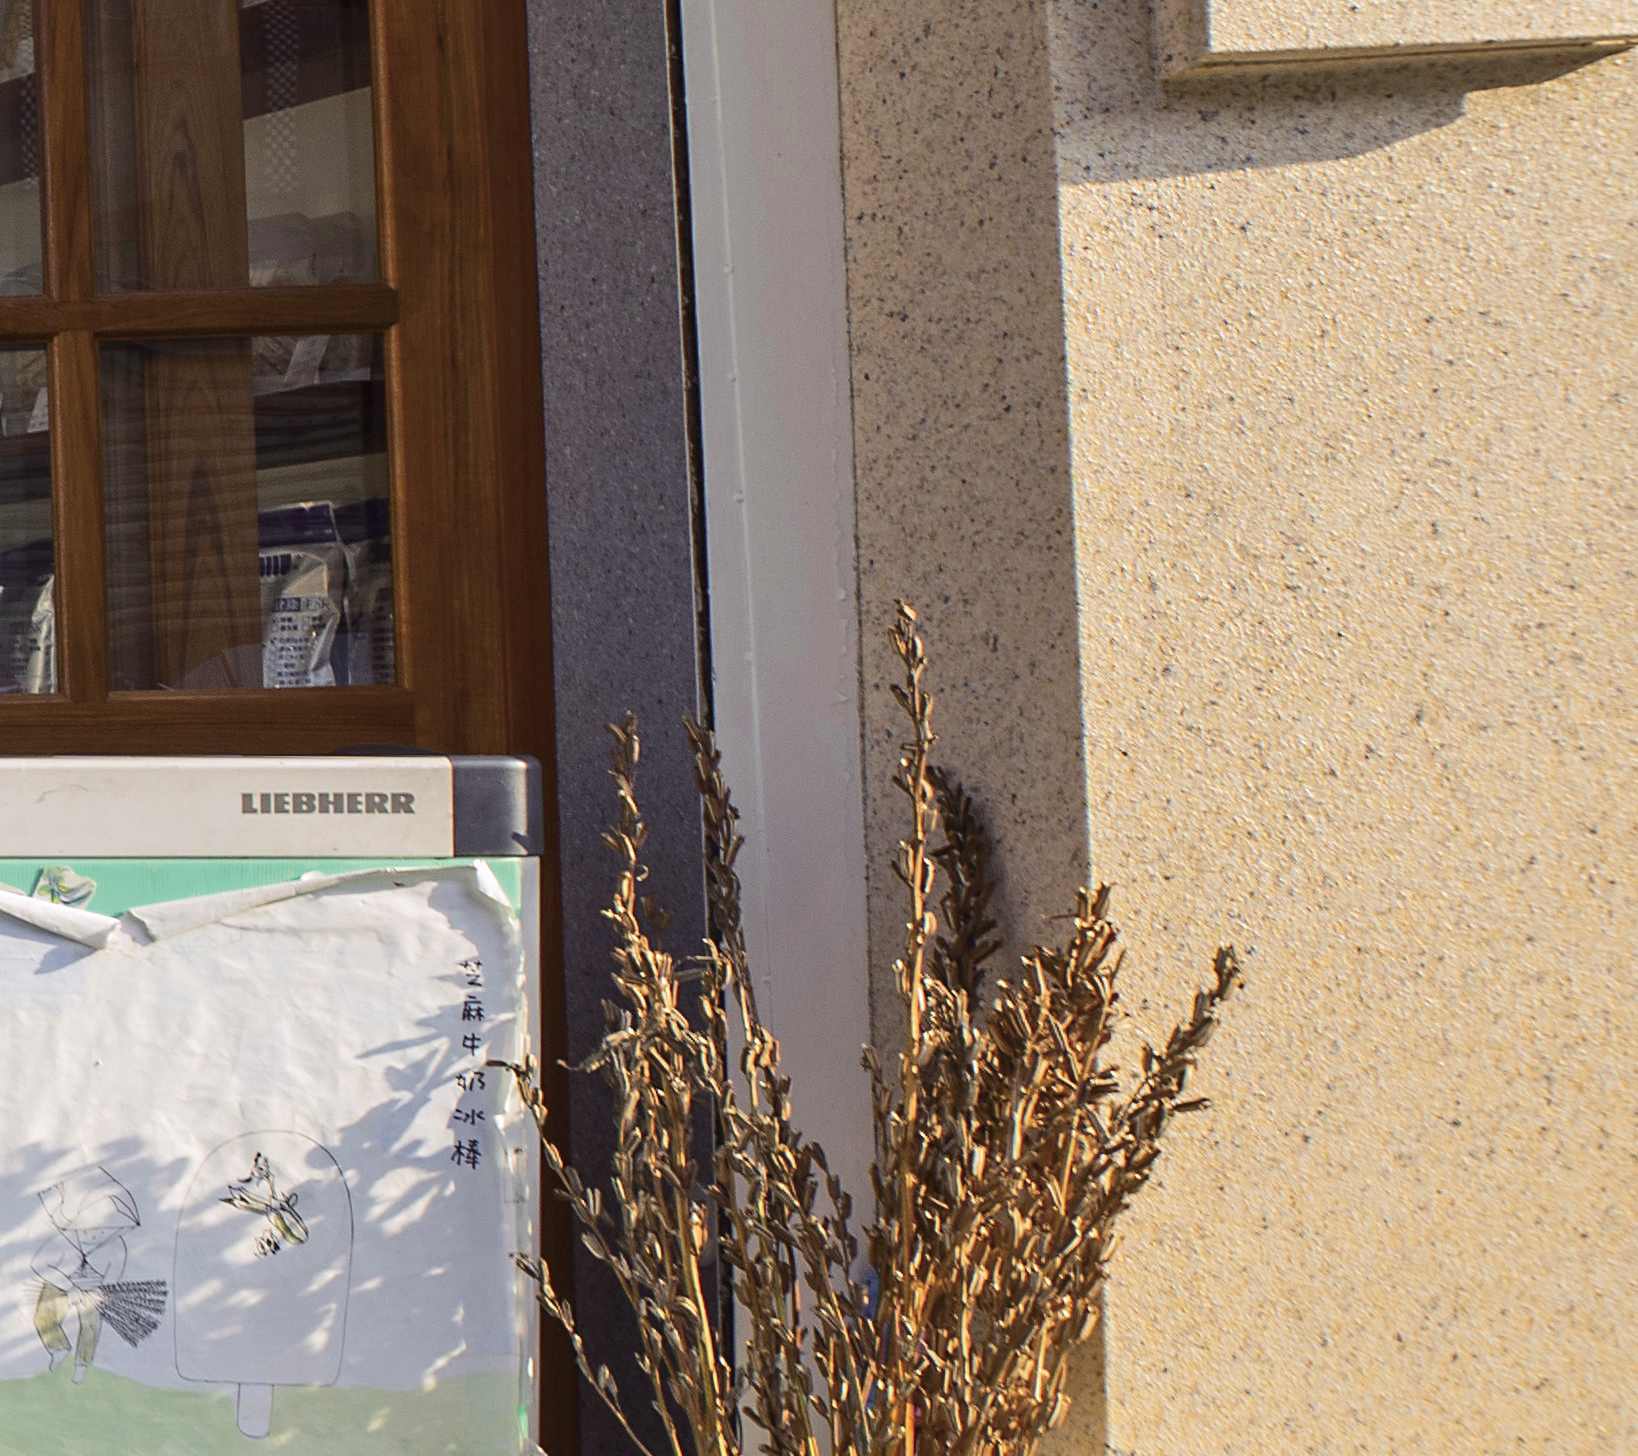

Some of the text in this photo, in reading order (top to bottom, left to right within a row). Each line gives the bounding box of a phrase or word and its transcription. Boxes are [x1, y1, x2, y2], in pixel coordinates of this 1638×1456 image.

[241, 792, 416, 815] LIEBHERR
[450, 959, 486, 1170] 芝麻牛奶冰棒
